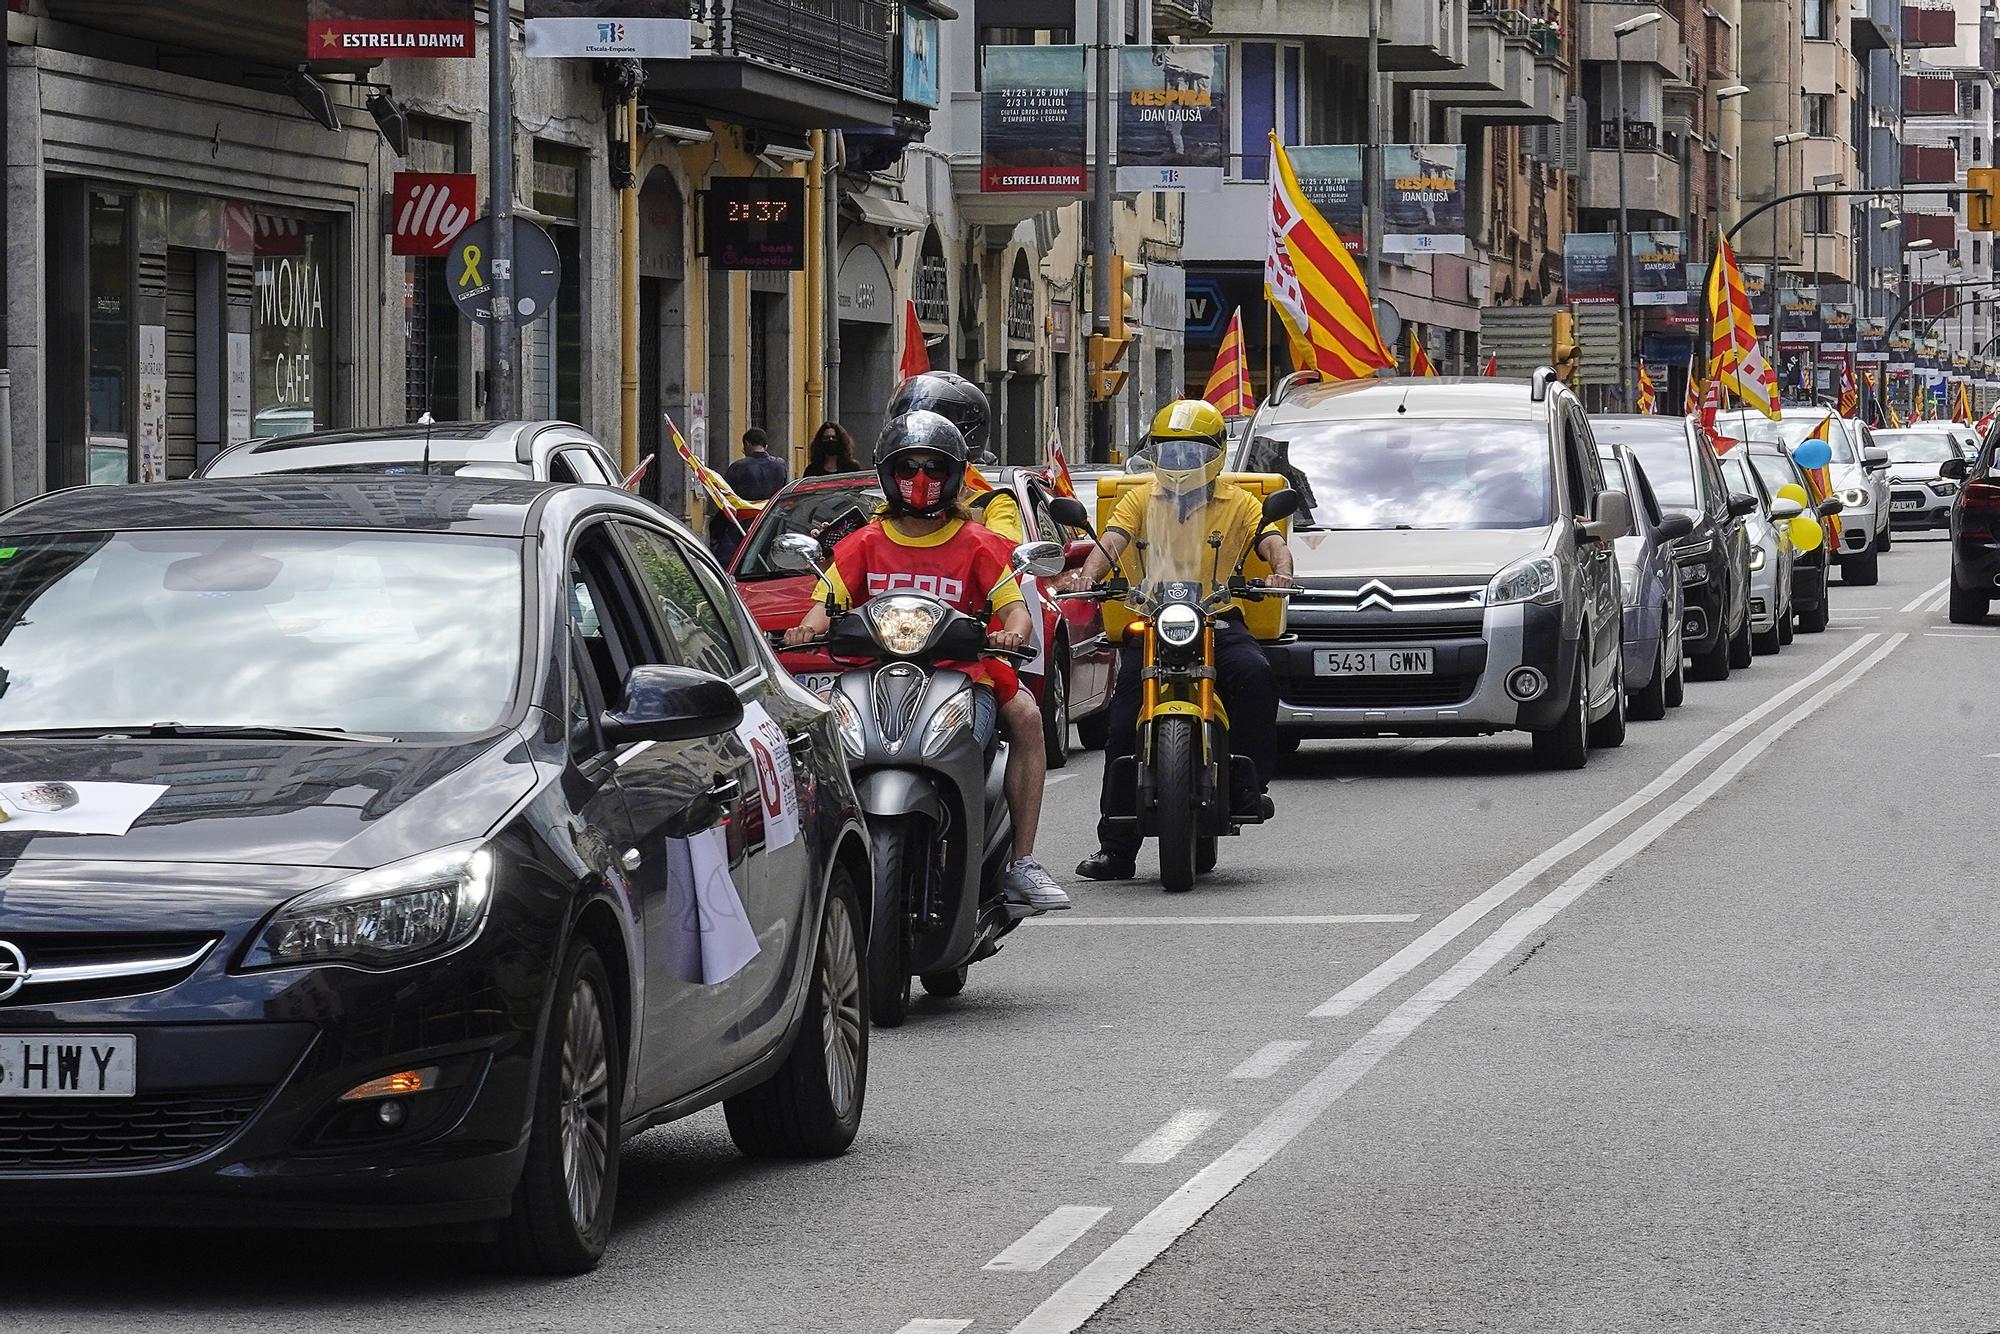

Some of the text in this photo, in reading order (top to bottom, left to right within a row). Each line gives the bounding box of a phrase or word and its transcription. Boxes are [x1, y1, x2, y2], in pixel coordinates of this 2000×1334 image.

[342, 33, 465, 48] ESTRELLA DAMM
[1001, 89, 1027, 98] 24/25
[1036, 88, 1046, 97] 26
[1048, 88, 1070, 97] JUNY
[1130, 88, 1212, 108] RESPIRA
[1006, 98, 1021, 107] 2/3
[1030, 98, 1035, 107] 4
[1038, 98, 1066, 107] JULIOL
[1139, 106, 1202, 123] JOAN DAUSÀ
[1002, 175, 1080, 185] ESTRELLA DAMM
[1401, 191, 1422, 202] JOAN
[397, 183, 470, 249] illy
[729, 201, 787, 221] 2:37
[260, 258, 324, 329] MOMA
[1786, 355, 1799, 375] AR
[1900, 501, 1916, 509] LMV
[1328, 652, 1427, 672] 5431 GWN
[23, 1044, 116, 1091] HWY
